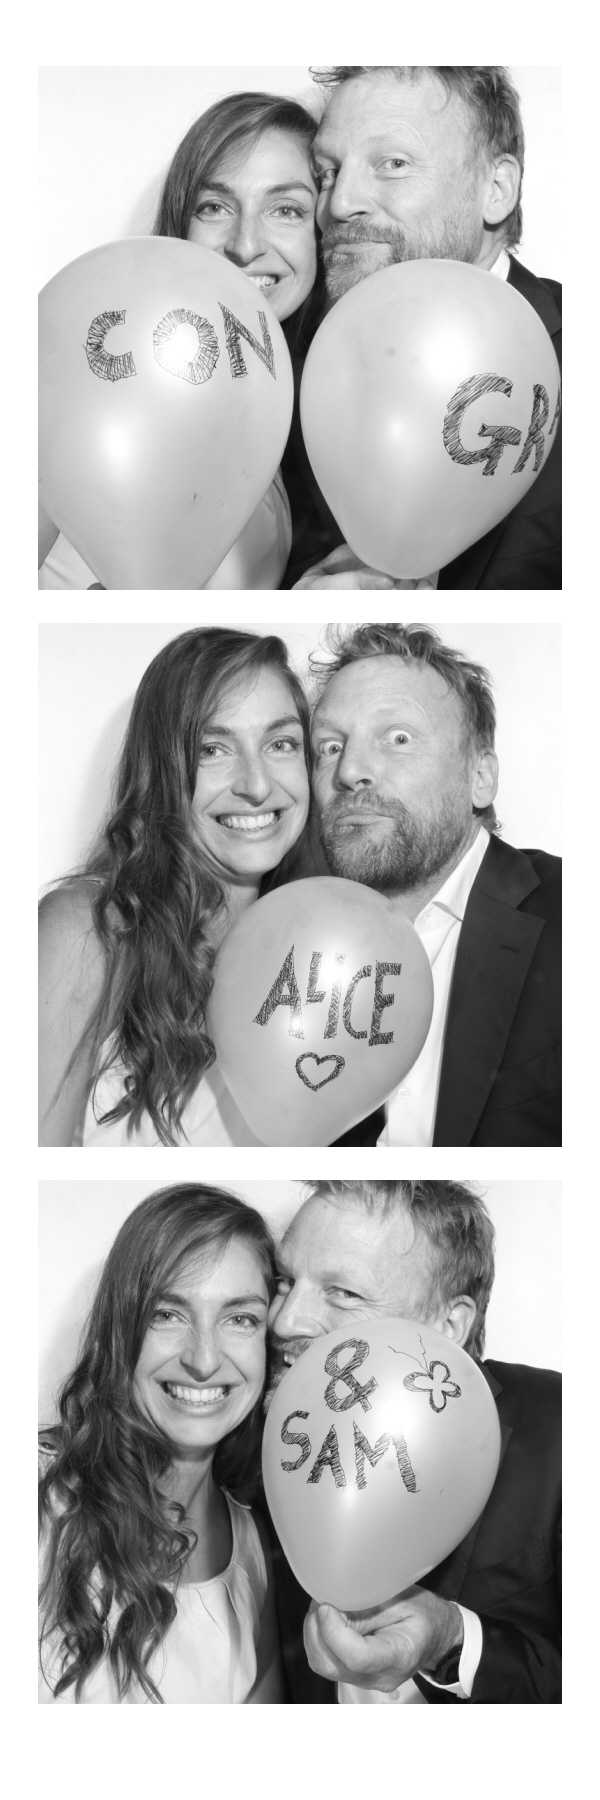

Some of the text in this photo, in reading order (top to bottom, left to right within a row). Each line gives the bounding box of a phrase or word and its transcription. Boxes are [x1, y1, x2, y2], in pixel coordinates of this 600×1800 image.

[82, 301, 276, 385] CON
[442, 372, 561, 476] GR
[252, 943, 402, 1047] ALICE
[324, 1338, 380, 1413] &
[280, 1410, 421, 1493] SAM
